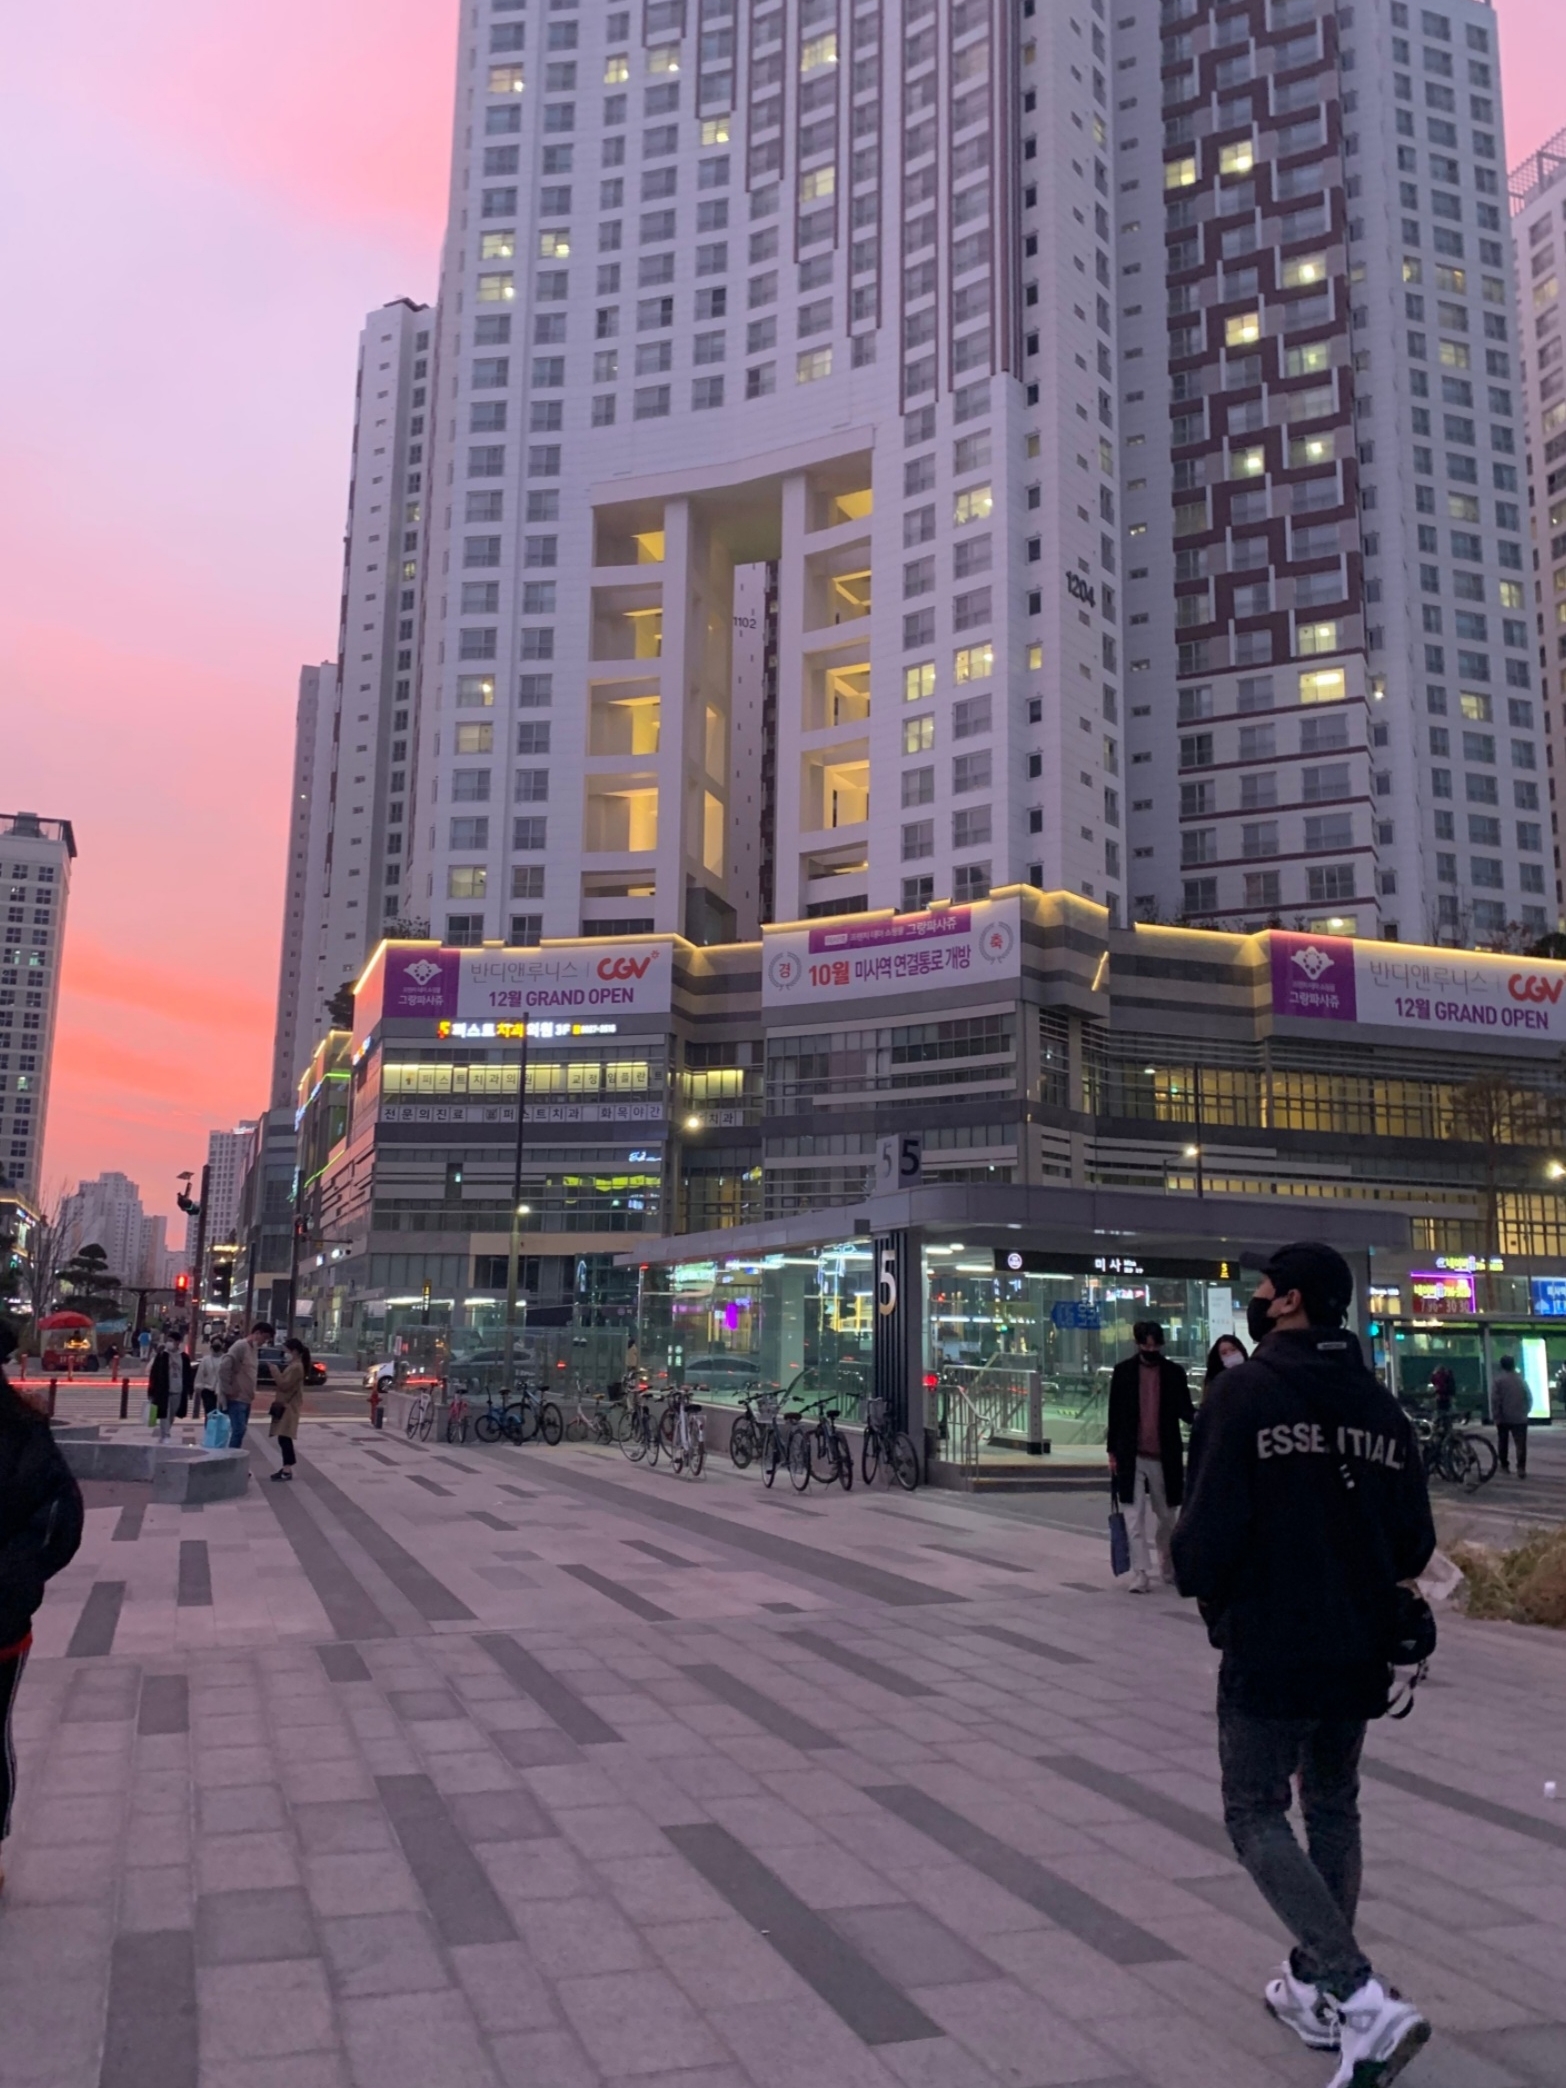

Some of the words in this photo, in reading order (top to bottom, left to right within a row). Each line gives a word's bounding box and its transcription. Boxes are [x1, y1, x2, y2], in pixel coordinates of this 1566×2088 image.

[1065, 570, 1096, 608] 1204
[733, 616, 757, 629] 1102
[906, 917, 957, 935] 그랑파사쥬
[990, 932, 1004, 950] 축
[470, 961, 578, 983] 반디앤루니스
[596, 957, 651, 981] CGV
[779, 963, 791, 978] 경
[809, 960, 850, 986] 10월
[855, 957, 891, 982] 미사역
[894, 949, 944, 978] 연결통로
[946, 944, 971, 970] 개방
[1370, 961, 1488, 995] 반디앤루니스
[1508, 973, 1564, 1004] CGV
[398, 995, 443, 1006] 그랑파사쥬
[489, 990, 522, 1007] 12월
[526, 989, 584, 1007] GRAND
[588, 987, 634, 1005] OPEN
[1289, 991, 1340, 1009] 그랑파사쥬
[1395, 997, 1431, 1020] 12월
[1435, 1001, 1497, 1025] GRAND
[1501, 1007, 1549, 1030] OPEN
[571, 1073, 598, 1086] 교정
[384, 1108, 464, 1120] 전문의진료
[601, 1105, 661, 1119] 화목야간
[882, 1141, 892, 1179] 5
[900, 1138, 920, 1177] 5
[1094, 1257, 1122, 1273] 미사
[879, 1249, 897, 1317] 5
